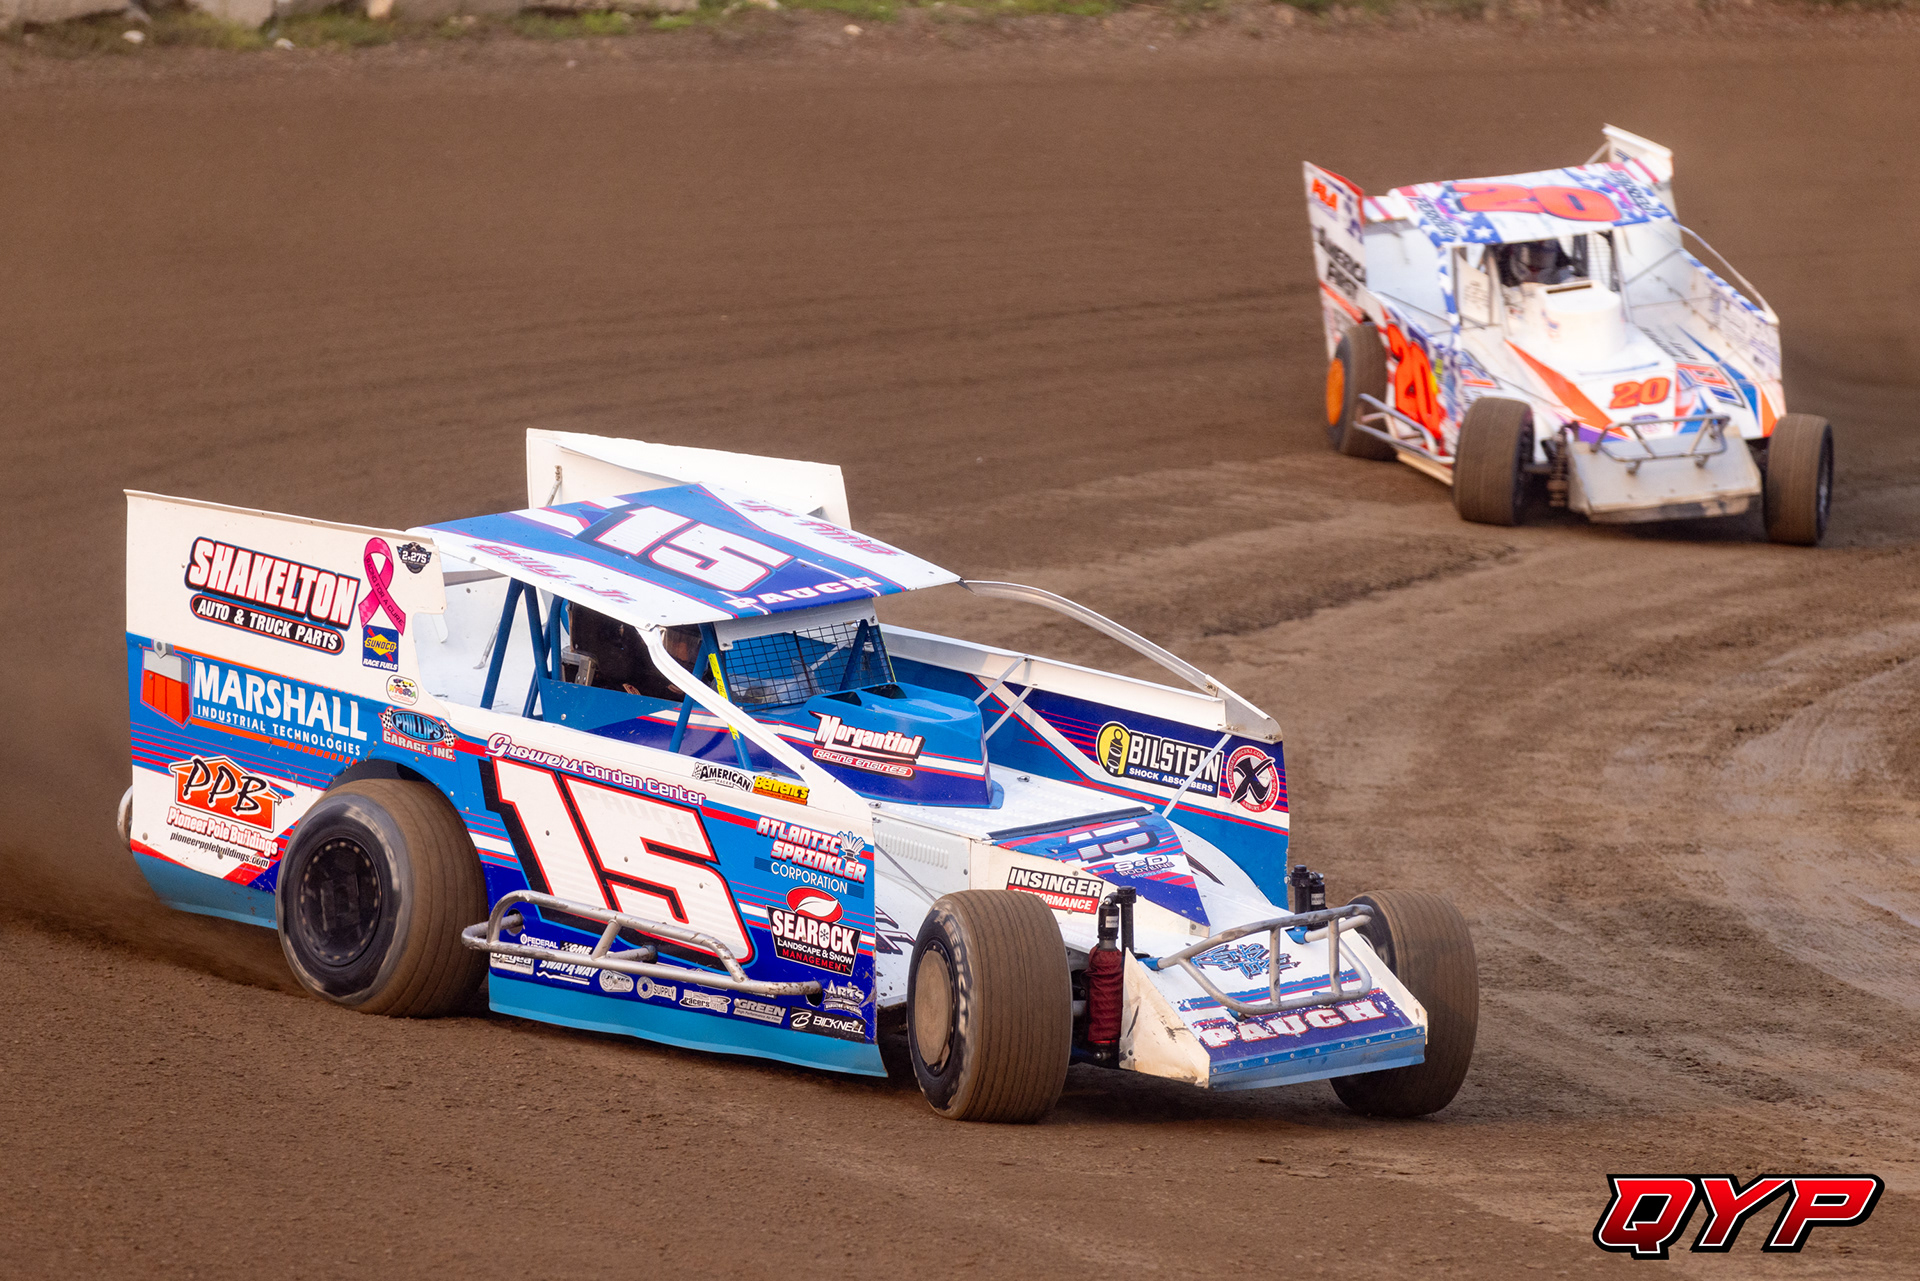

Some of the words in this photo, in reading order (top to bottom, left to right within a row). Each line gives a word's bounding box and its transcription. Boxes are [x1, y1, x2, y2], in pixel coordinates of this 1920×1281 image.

[1452, 182, 1622, 222] 20
[1609, 377, 1670, 410] 20
[401, 550, 427, 564] 2,275
[594, 505, 796, 593] 15
[187, 538, 360, 627] SHAKELTON
[366, 557, 378, 584] RACING
[375, 583, 385, 599] FOR
[387, 604, 405, 627] CURE
[723, 576, 883, 609] PAUCH
[196, 599, 230, 621] AUTO
[233, 608, 244, 626] &
[249, 613, 293, 639] TRUCK
[295, 625, 338, 651] PARTS
[366, 638, 396, 651] SUNOCO
[362, 658, 380, 667] RACE
[380, 661, 398, 671] FUELS
[193, 660, 368, 741] MARSHALL
[197, 704, 266, 732] INDUSTRIAL
[272, 723, 361, 757] TECHNOLOGIES
[395, 714, 441, 740] PHILLIPS
[810, 711, 924, 758] Morgantini
[383, 730, 431, 756] GARAGE,
[433, 746, 456, 761] INC.
[1128, 734, 1221, 783] BILSTEIN
[485, 733, 580, 774] Growers
[582, 761, 644, 790] Garden
[646, 777, 706, 806] Center
[700, 765, 751, 792] AMERICAN
[815, 750, 853, 765] RACING
[855, 758, 909, 776] ENGINES
[183, 758, 267, 812] PPB
[1129, 767, 1160, 781] SHOCK
[1161, 774, 1214, 793] ABSOBERS
[167, 807, 207, 836] Pioneer
[207, 818, 230, 842] Pole
[231, 825, 279, 858] Buildings
[757, 816, 842, 856] ATLANTIC
[170, 831, 269, 868] pioneerpolebuildings.com
[493, 755, 752, 967] 15
[771, 840, 867, 883] SPRINKLER
[771, 861, 848, 894] CORPORATION
[1008, 868, 1103, 897] INSINGER
[1119, 860, 1175, 877] BODYLINE
[527, 936, 559, 949] FEDERAL
[569, 943, 593, 955] GME
[772, 910, 855, 956] SEAROCK
[782, 949, 848, 973] MANAGEMENT
[822, 949, 829, 958] &
[653, 985, 675, 998] SUPPLY
[740, 999, 787, 1017] GREEN
[812, 1015, 864, 1035] BICKNELL
[1199, 999, 1387, 1049] PAUCH
